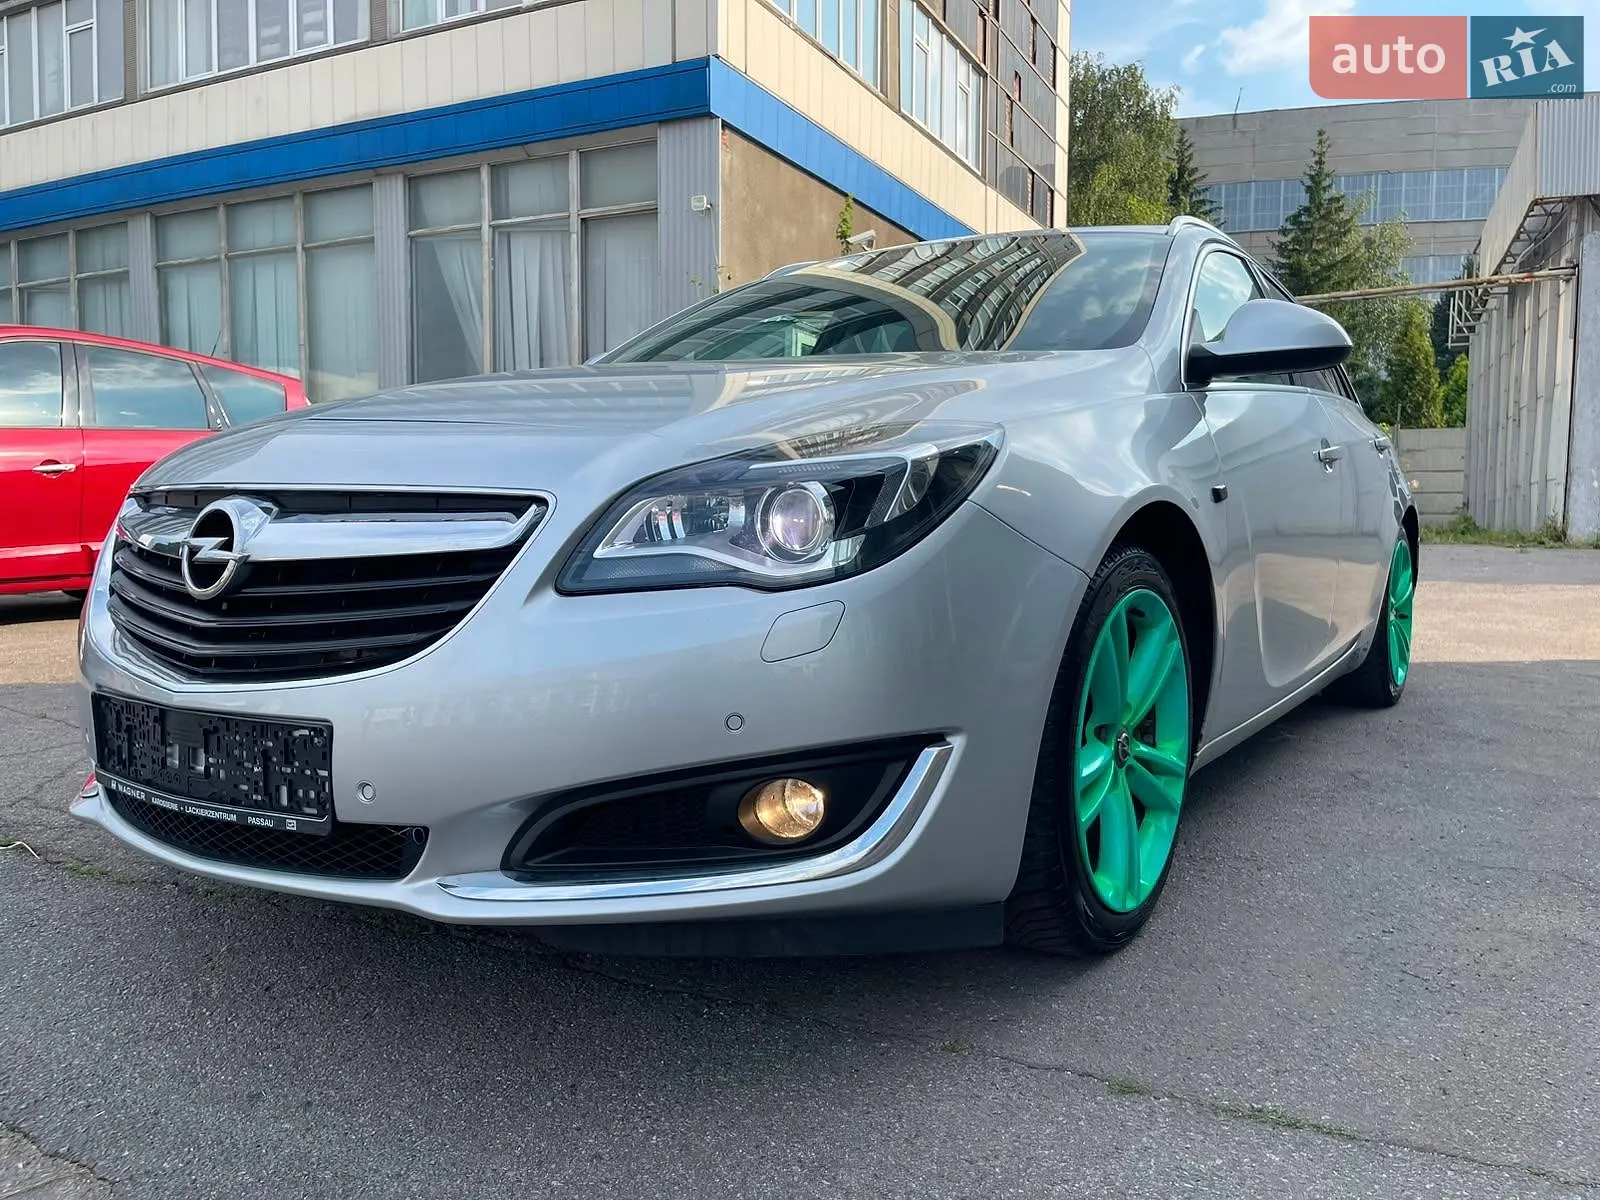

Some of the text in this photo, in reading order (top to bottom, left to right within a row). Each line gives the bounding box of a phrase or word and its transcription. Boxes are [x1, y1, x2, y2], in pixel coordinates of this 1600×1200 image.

[118, 782, 146, 801] WAGNER
[184, 805, 237, 822] LACKIERZENTRUM
[247, 816, 274, 828] PASSAU
